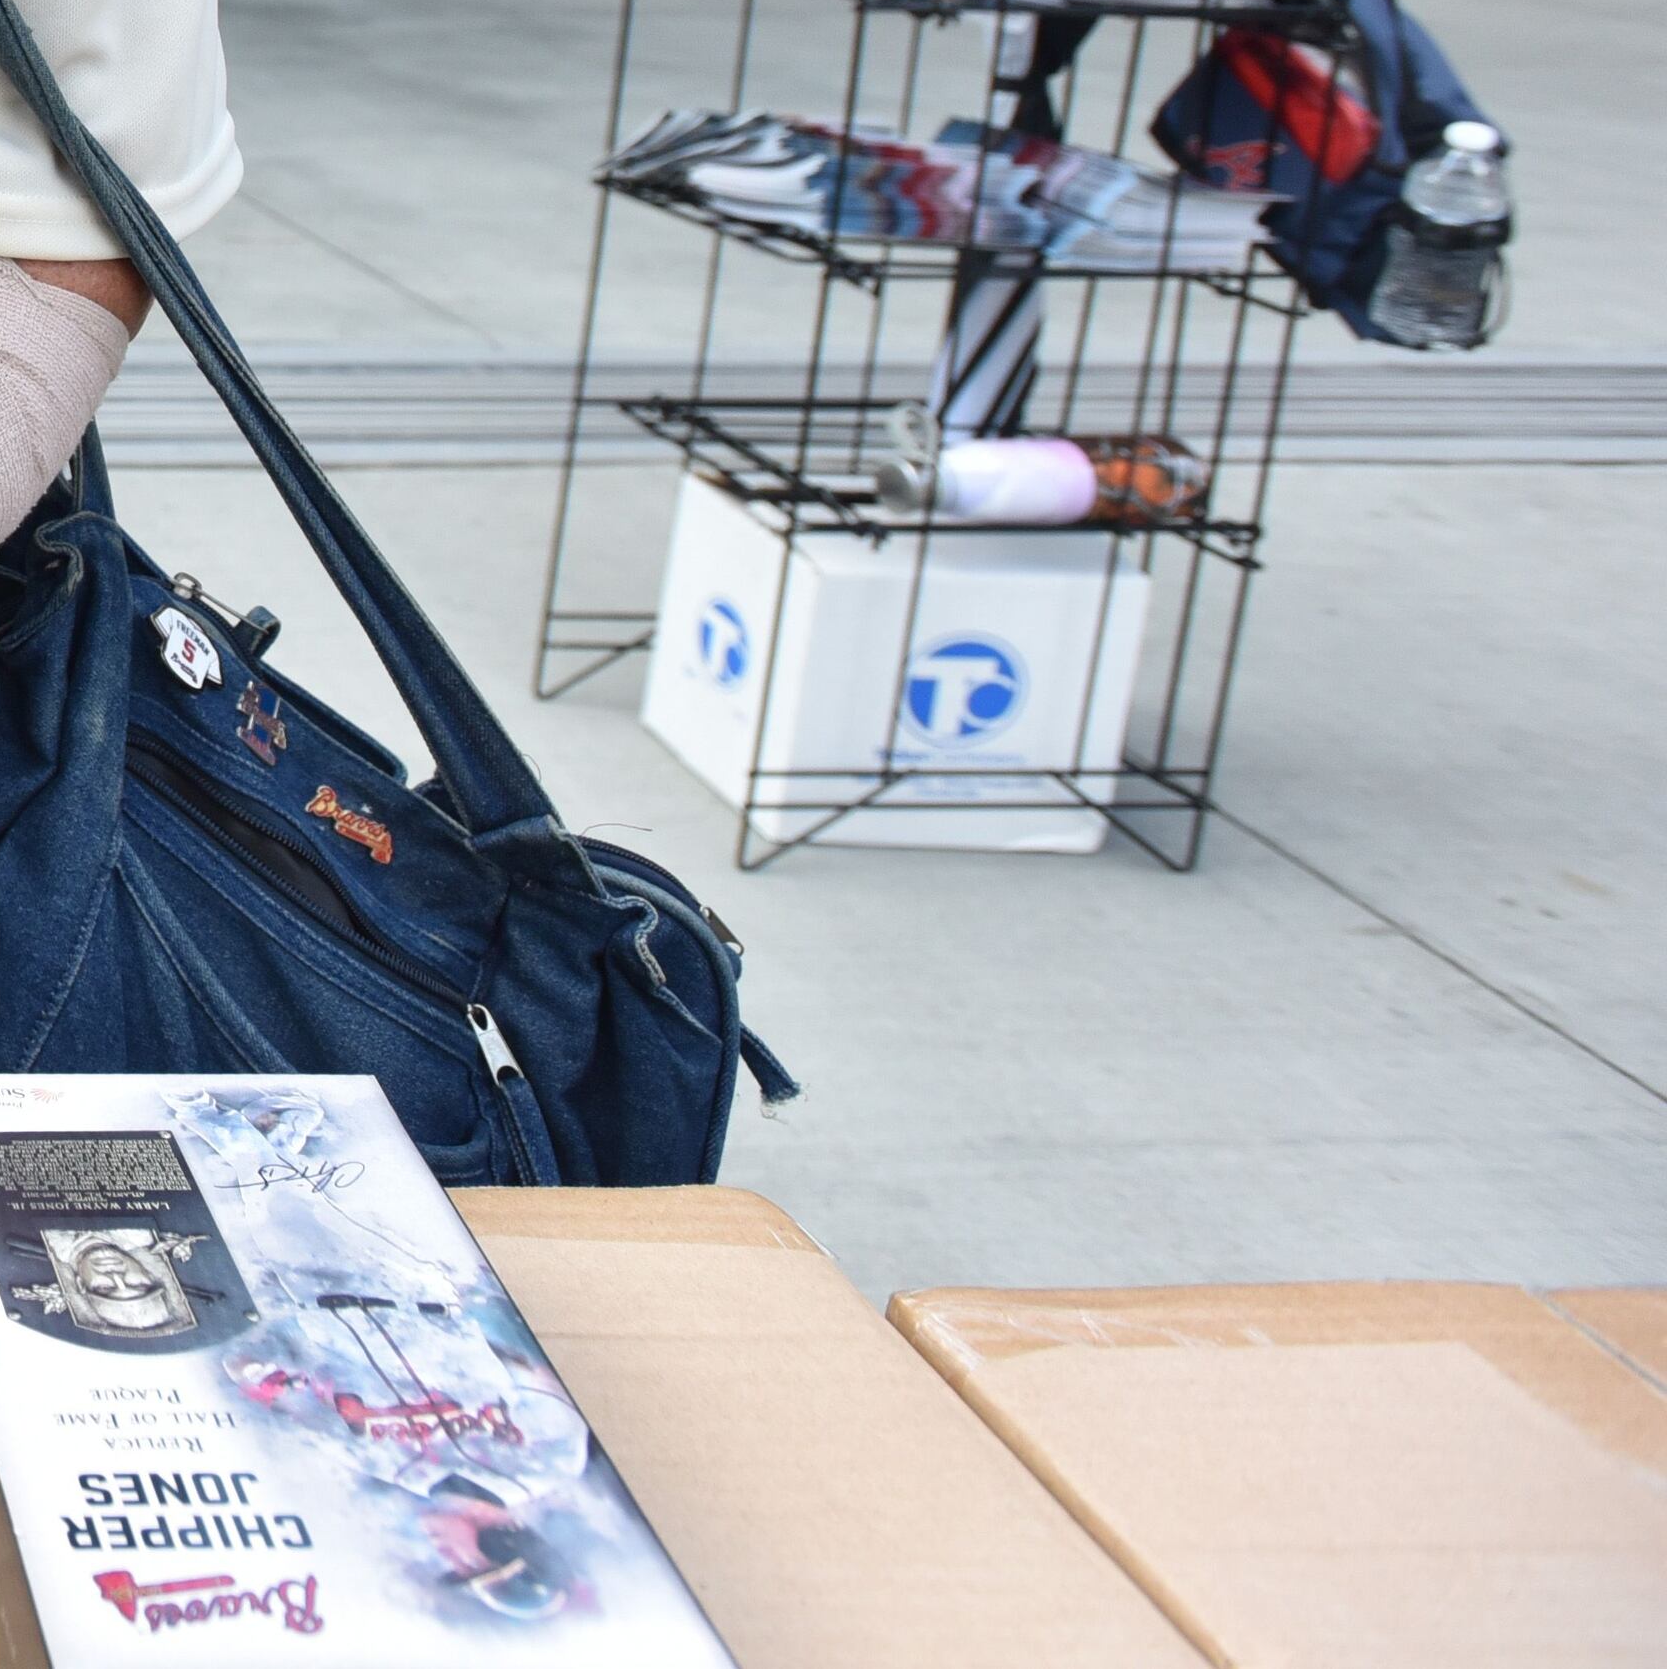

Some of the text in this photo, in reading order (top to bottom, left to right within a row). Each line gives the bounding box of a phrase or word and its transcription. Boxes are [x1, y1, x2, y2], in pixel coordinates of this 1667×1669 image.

[180, 638, 197, 664] 5
[29, 1201, 72, 1211] JONES
[75, 1201, 123, 1211] WAYNE
[125, 1201, 171, 1211] LARRY
[77, 1472, 260, 1507] JONES
[60, 1514, 314, 1550] CHIPPER
[143, 1575, 325, 1634] Braves
